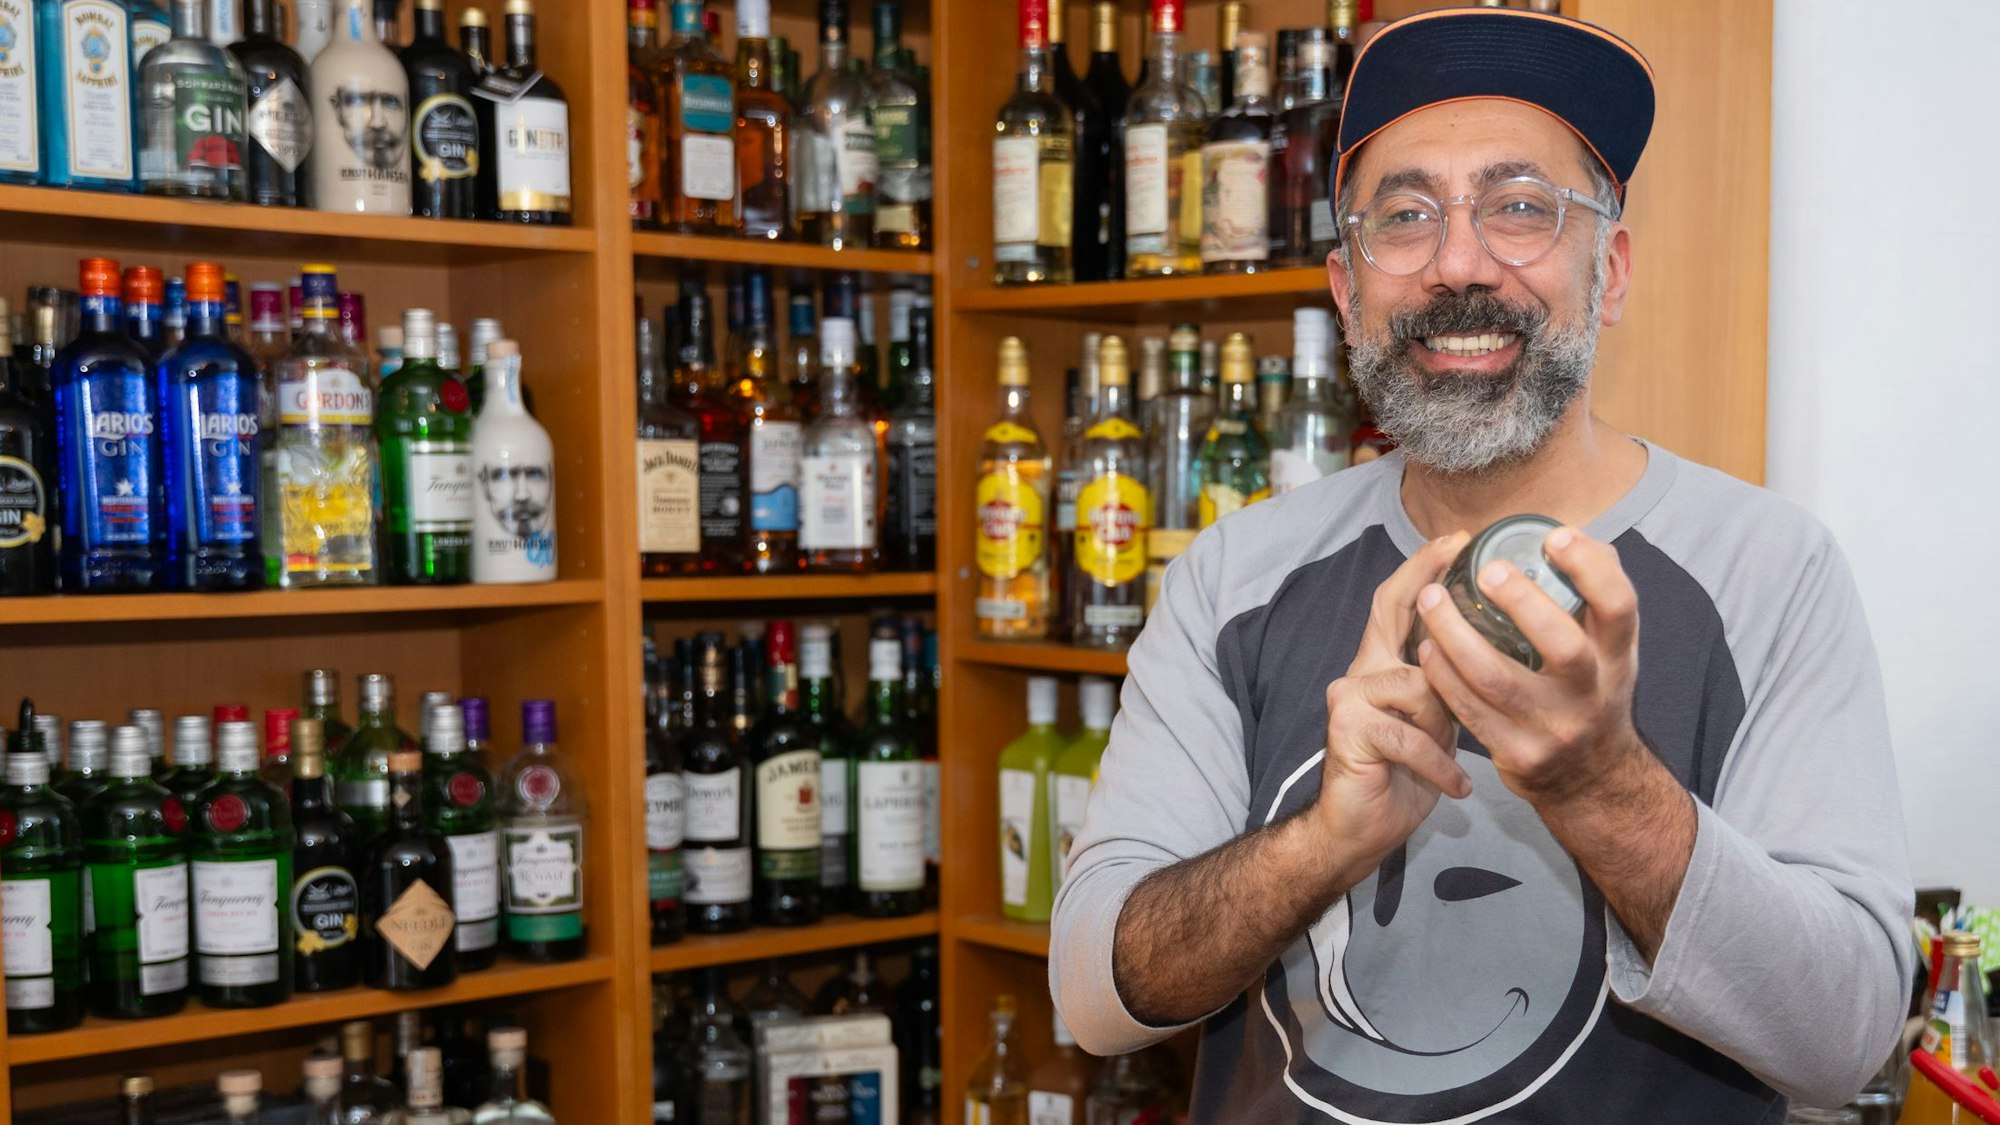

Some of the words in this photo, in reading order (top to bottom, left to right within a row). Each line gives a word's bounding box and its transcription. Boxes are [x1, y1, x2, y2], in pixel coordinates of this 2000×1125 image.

[75, 12, 114, 29] BOMBAY
[76, 70, 118, 89] SAPPHIRE
[184, 104, 243, 133] GIN
[438, 143, 466, 158] GIN
[93, 412, 155, 440] LARIOS
[200, 414, 259, 440] LARIOS
[102, 440, 145, 457] GIN
[209, 440, 251, 457] GIN
[199, 889, 266, 909] Tanqueray
[316, 912, 344, 929] GIN
